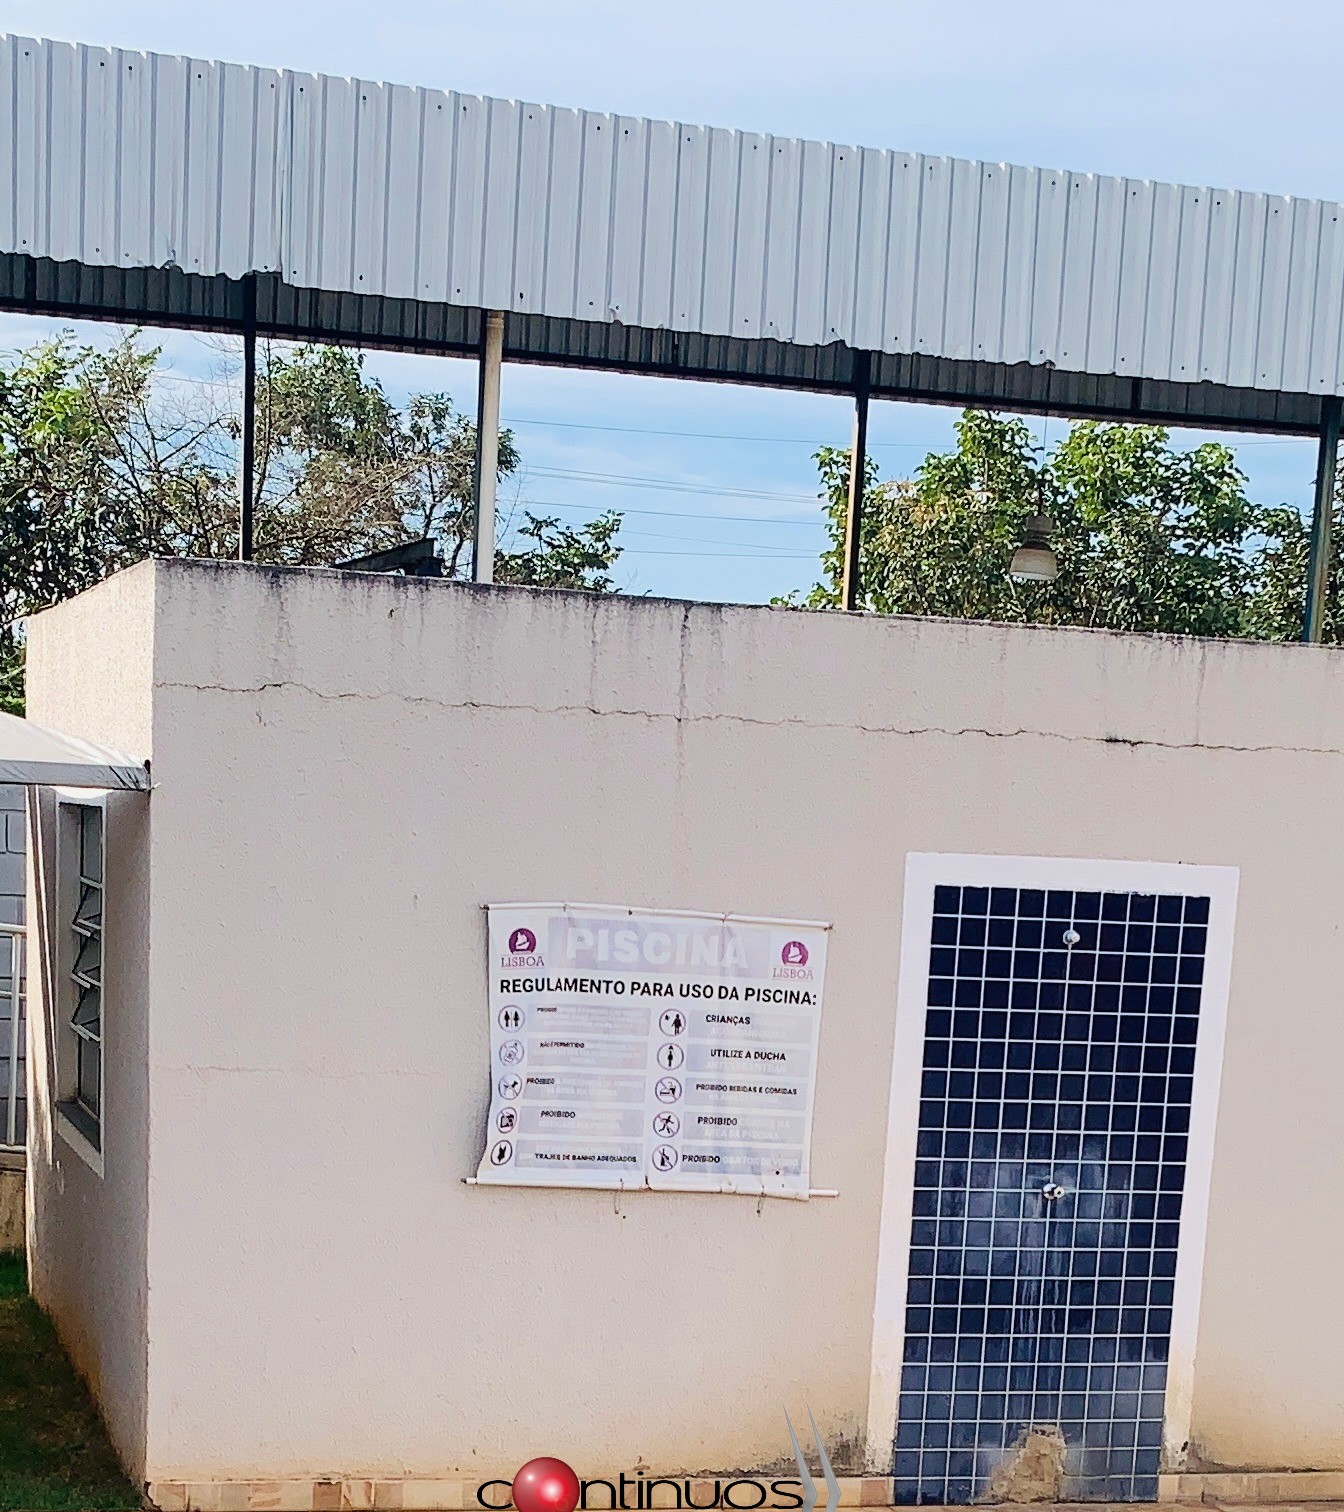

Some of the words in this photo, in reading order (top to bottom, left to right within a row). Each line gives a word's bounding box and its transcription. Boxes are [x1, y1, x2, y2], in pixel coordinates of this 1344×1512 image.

[566, 927, 748, 968] PISCINA
[501, 956, 545, 967] LISBOA
[772, 967, 814, 980] LISBOA
[500, 977, 625, 995] REGULAMENTO
[630, 981, 674, 997] PARA
[679, 984, 714, 999] USO
[718, 985, 739, 1000] DA
[745, 987, 817, 1006] PISCINA:
[705, 1014, 751, 1026] CRIANÇAS
[710, 1049, 743, 1059] UTILIZE
[744, 1051, 752, 1060] A
[754, 1051, 787, 1061] DUCHA
[540, 1110, 576, 1118] PROIBIDO
[697, 1116, 738, 1125] PROIBIDO
[682, 1154, 721, 1163] PROIBIDO
